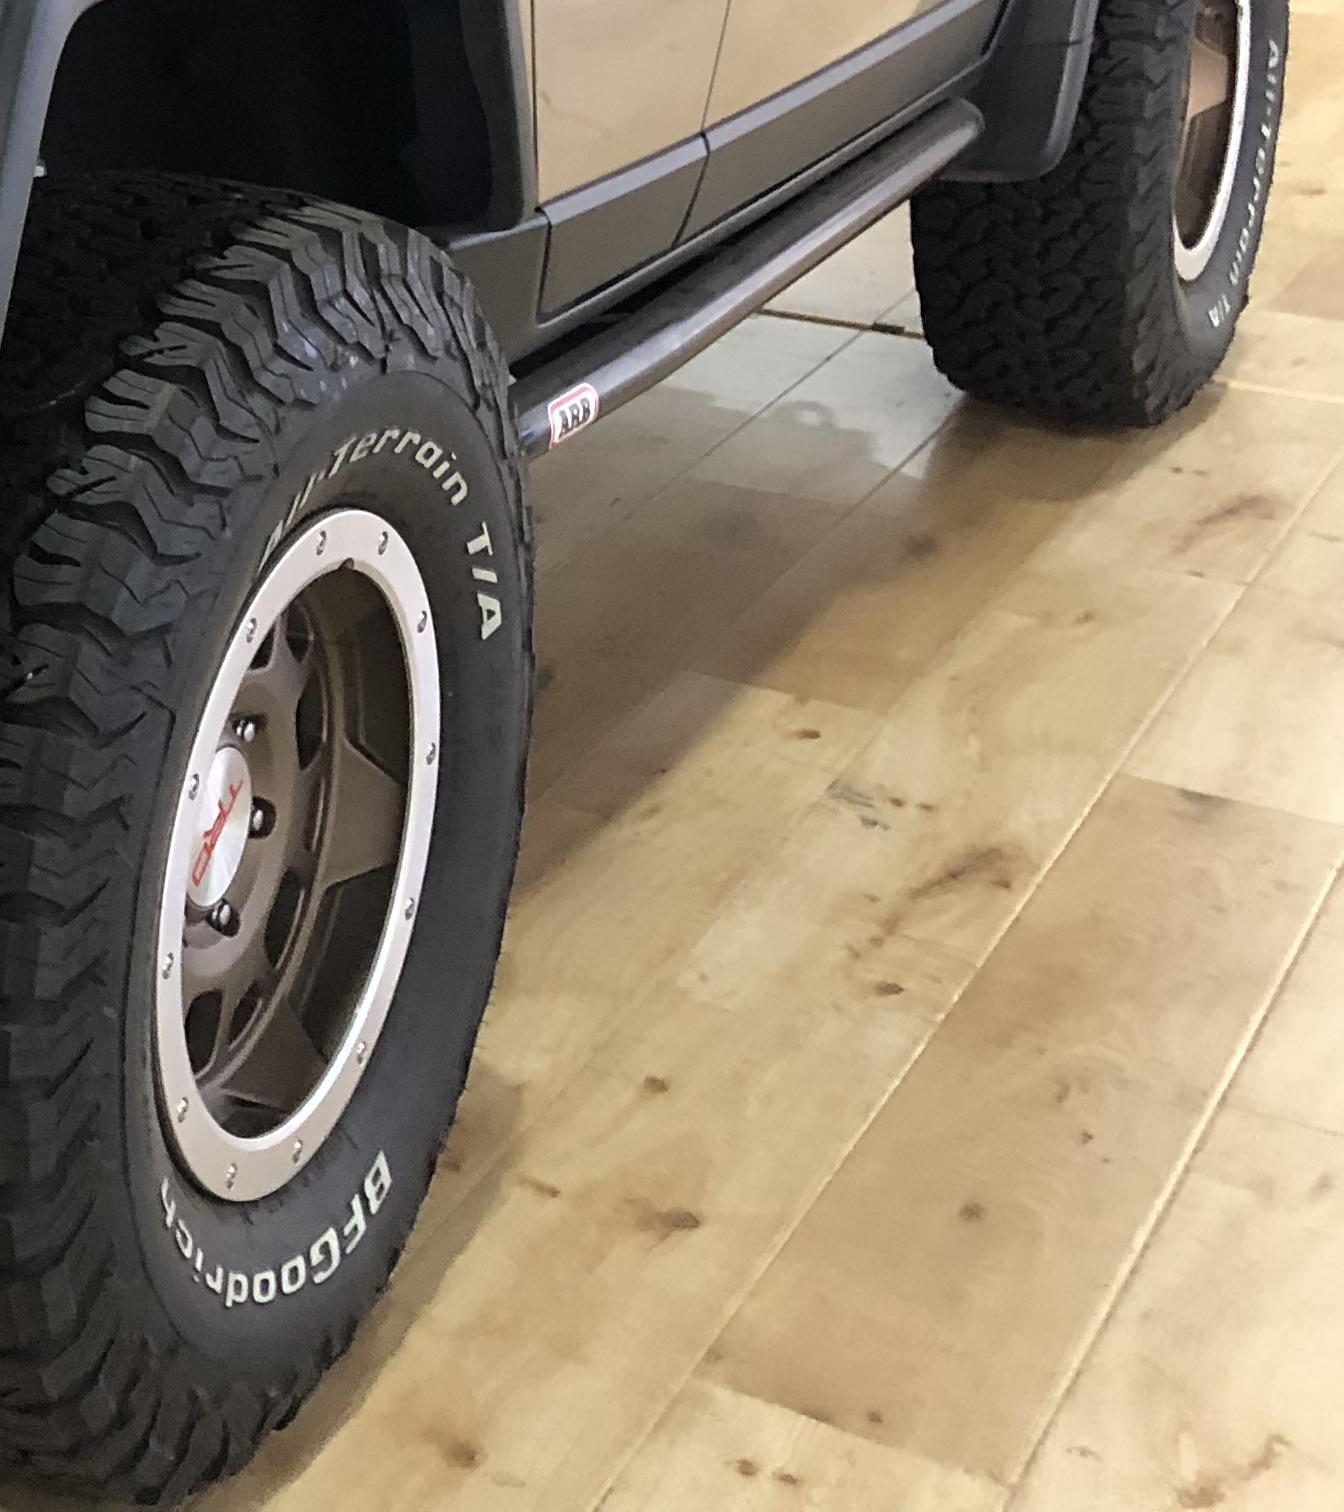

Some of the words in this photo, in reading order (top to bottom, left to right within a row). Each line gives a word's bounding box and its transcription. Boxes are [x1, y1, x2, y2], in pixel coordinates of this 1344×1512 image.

[466, 521, 502, 640] T/A
[191, 778, 244, 887] TRD
[161, 1149, 393, 1308] BFGoodrich
